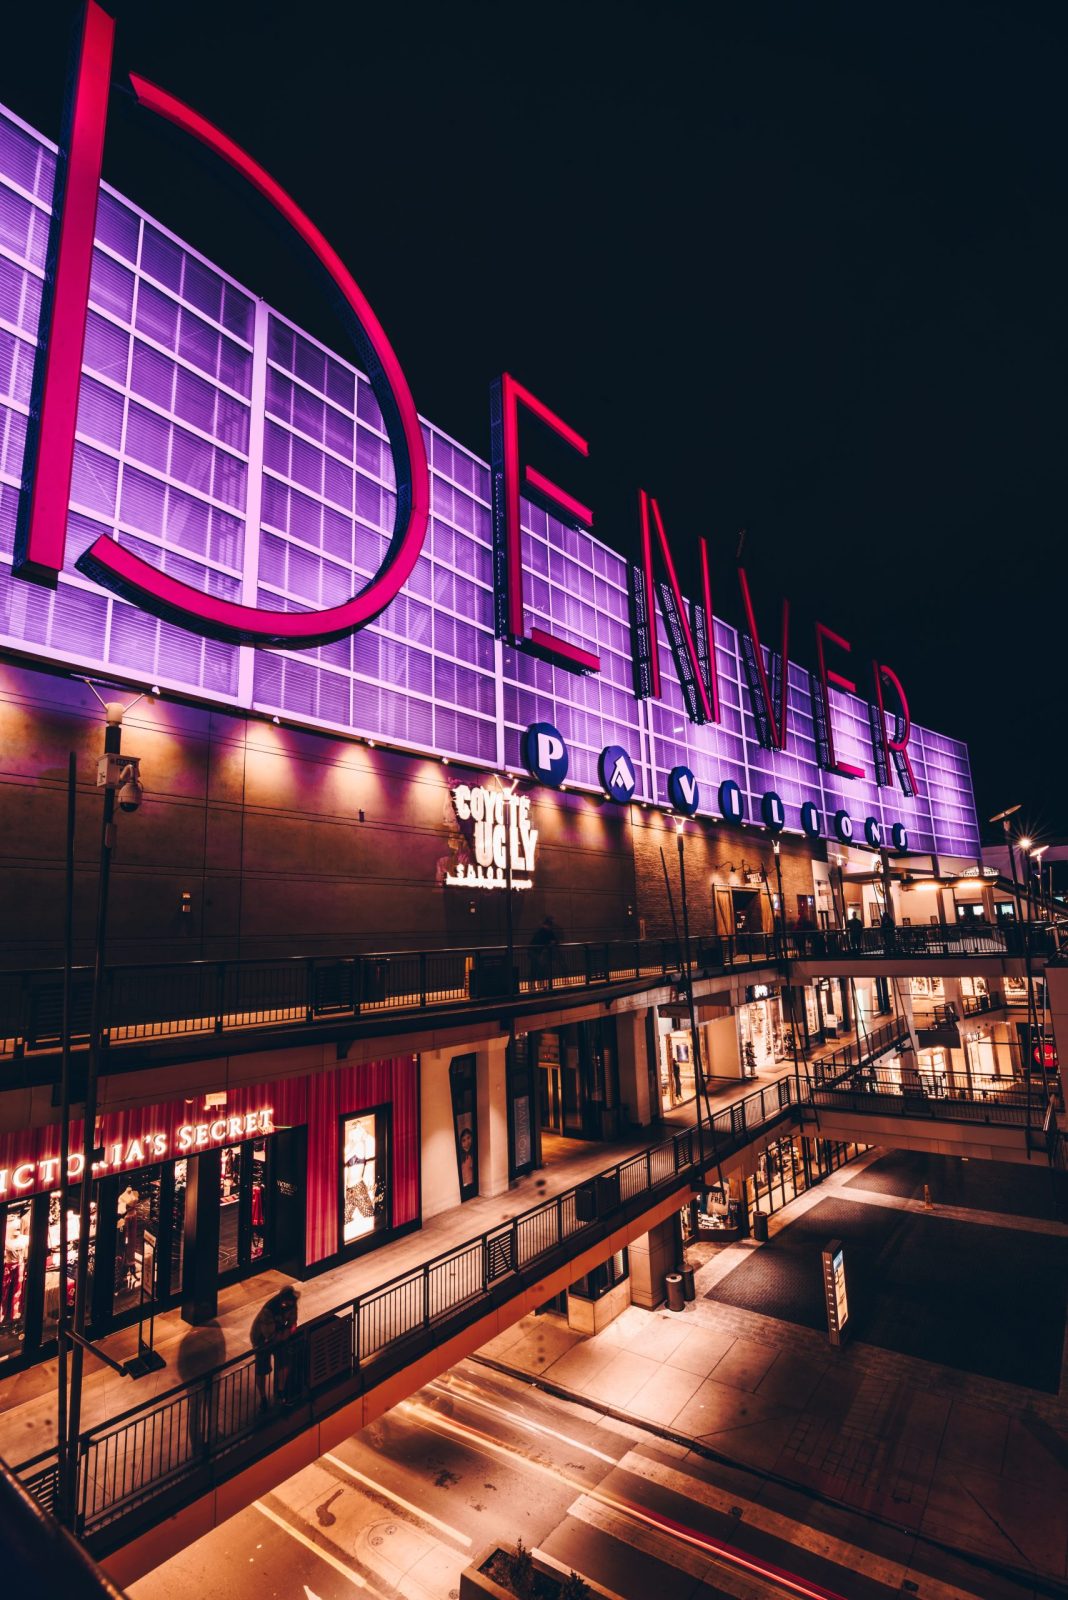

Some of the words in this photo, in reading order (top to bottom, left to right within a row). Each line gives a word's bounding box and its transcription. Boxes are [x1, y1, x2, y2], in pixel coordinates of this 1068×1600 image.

[14, 0, 917, 796] DENVER
[535, 731, 908, 848] PAVILIONS
[475, 821, 539, 871] UGLY
[456, 864, 507, 879] SALOO
[177, 1111, 274, 1149] SECRET
